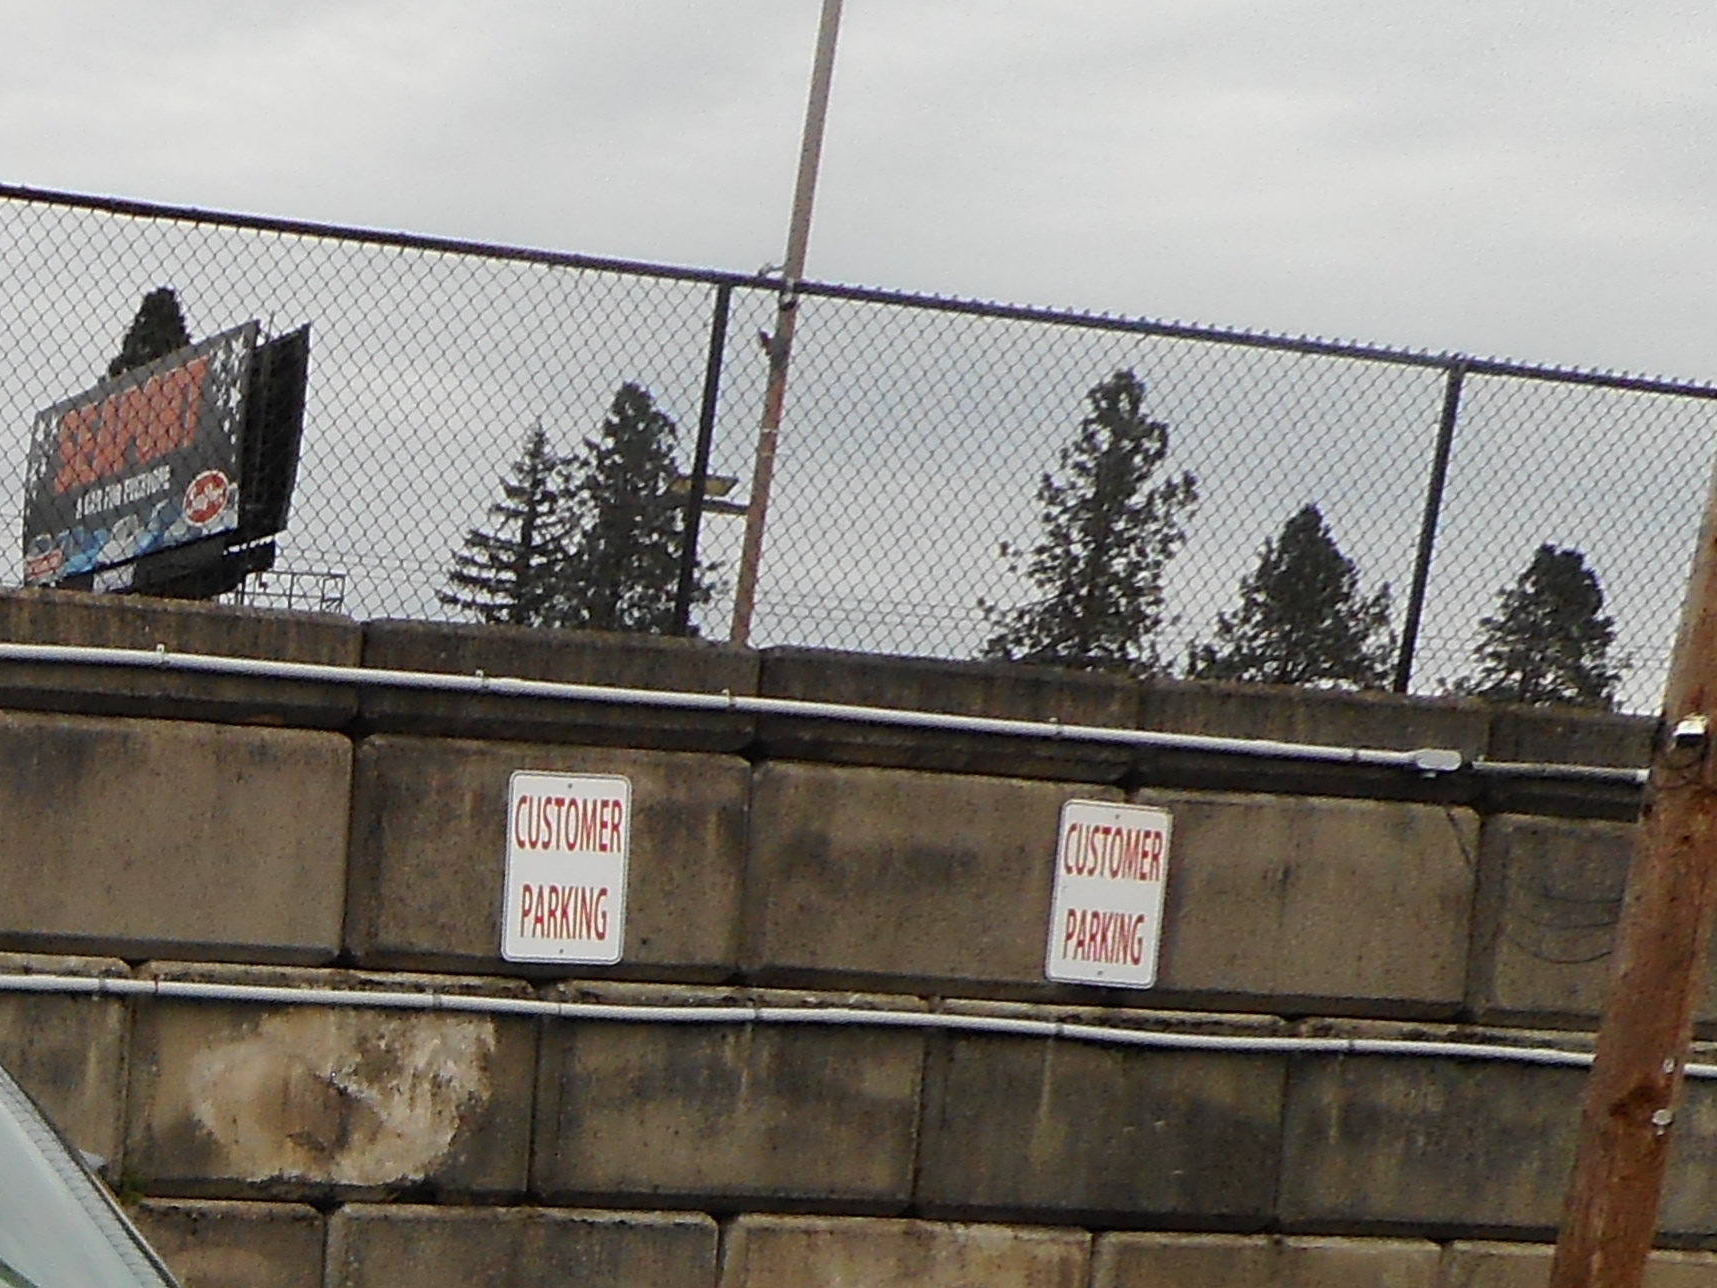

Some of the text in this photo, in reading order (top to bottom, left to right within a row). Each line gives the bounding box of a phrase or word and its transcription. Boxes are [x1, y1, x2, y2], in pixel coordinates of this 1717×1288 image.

[514, 794, 623, 854] CUSTOMER
[1063, 823, 1163, 882] CUSTOMER
[520, 883, 609, 941] PARKING
[1061, 908, 1146, 966] PARKING
